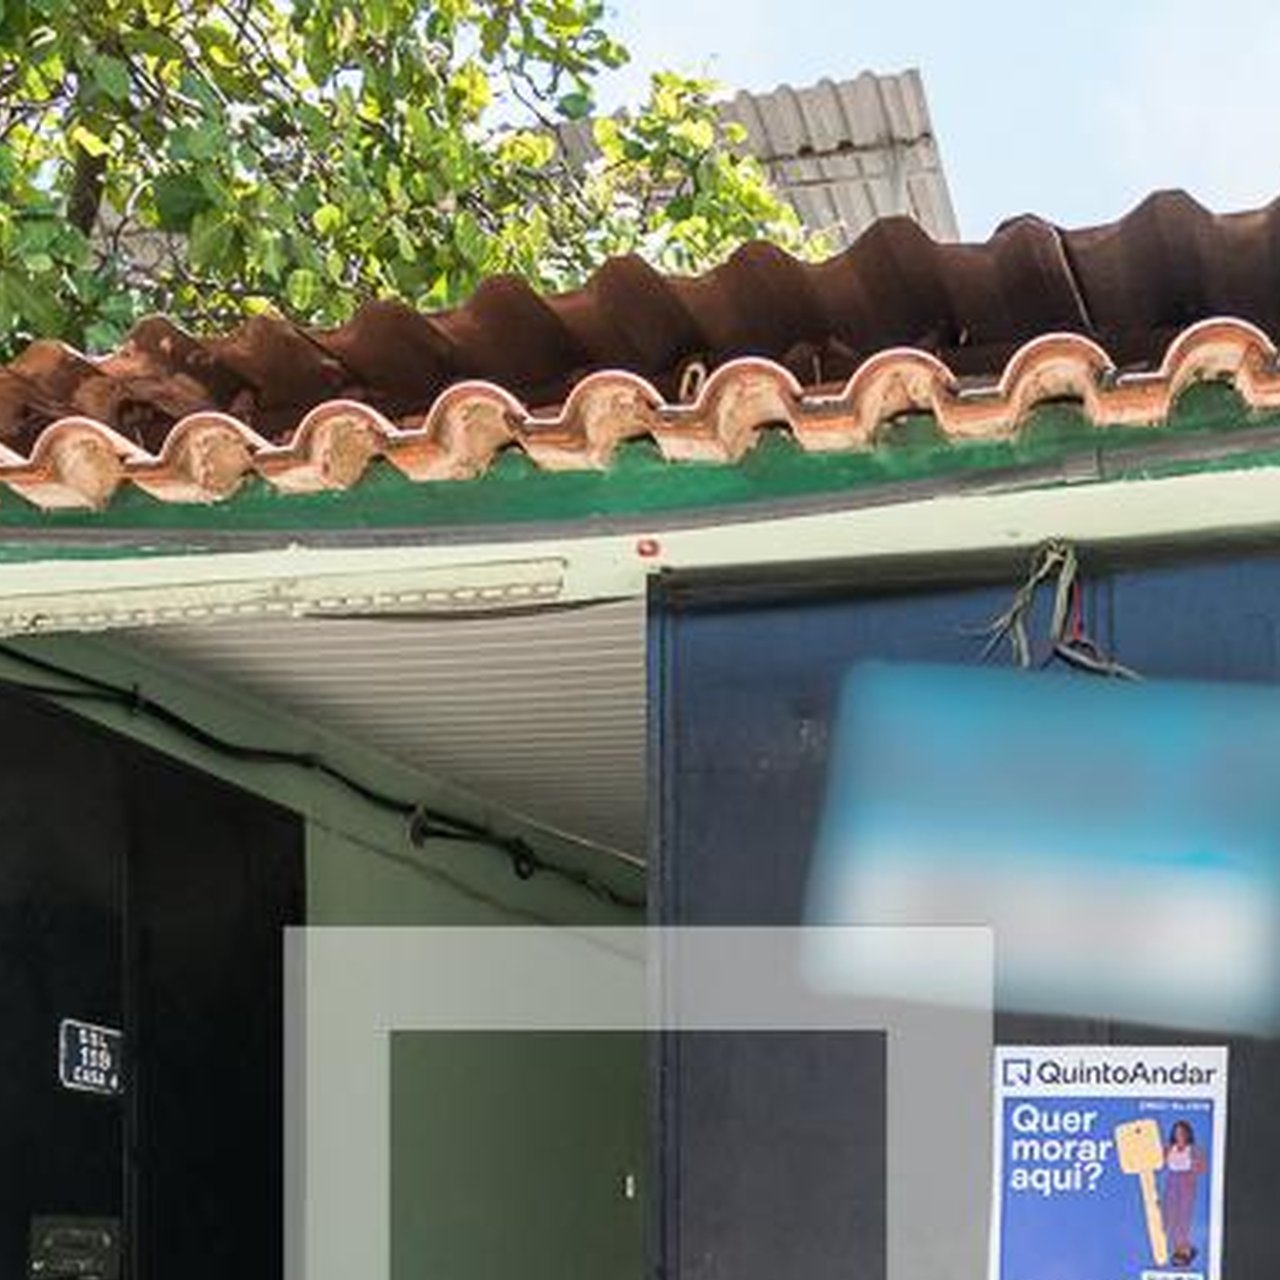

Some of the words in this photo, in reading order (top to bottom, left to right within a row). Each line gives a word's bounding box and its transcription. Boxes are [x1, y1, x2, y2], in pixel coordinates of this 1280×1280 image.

[1037, 1060, 1217, 1085] QuintoAndar
[1012, 1105, 1099, 1132] Quer
[1012, 1138, 1112, 1161] morar
[1011, 1163, 1103, 1195] aqui?
